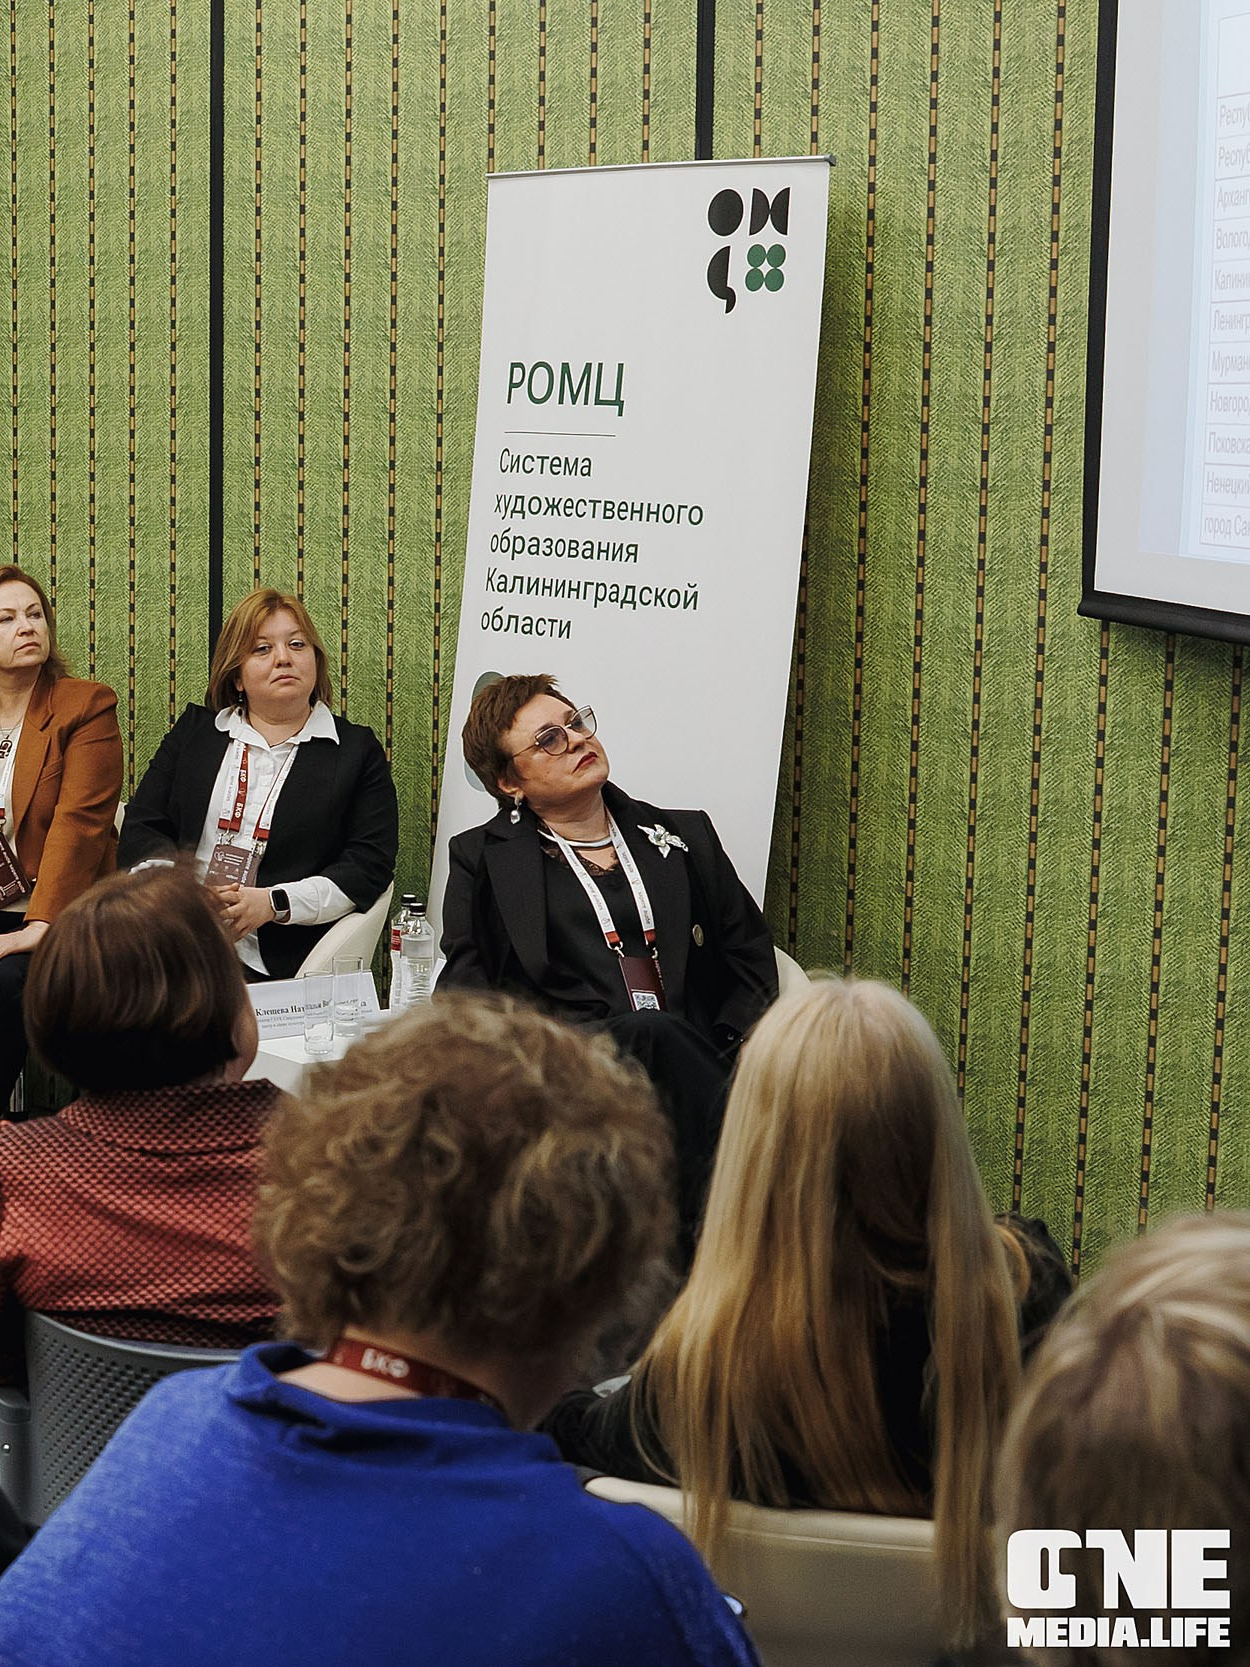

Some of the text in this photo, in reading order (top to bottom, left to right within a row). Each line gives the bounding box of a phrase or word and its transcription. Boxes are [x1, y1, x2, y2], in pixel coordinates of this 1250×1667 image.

[507, 361, 625, 417] РОМЦ
[499, 447, 592, 477] Система
[494, 494, 704, 525] художественного
[490, 527, 639, 563] образования
[486, 567, 699, 610] Калининградской
[481, 606, 572, 639] области
